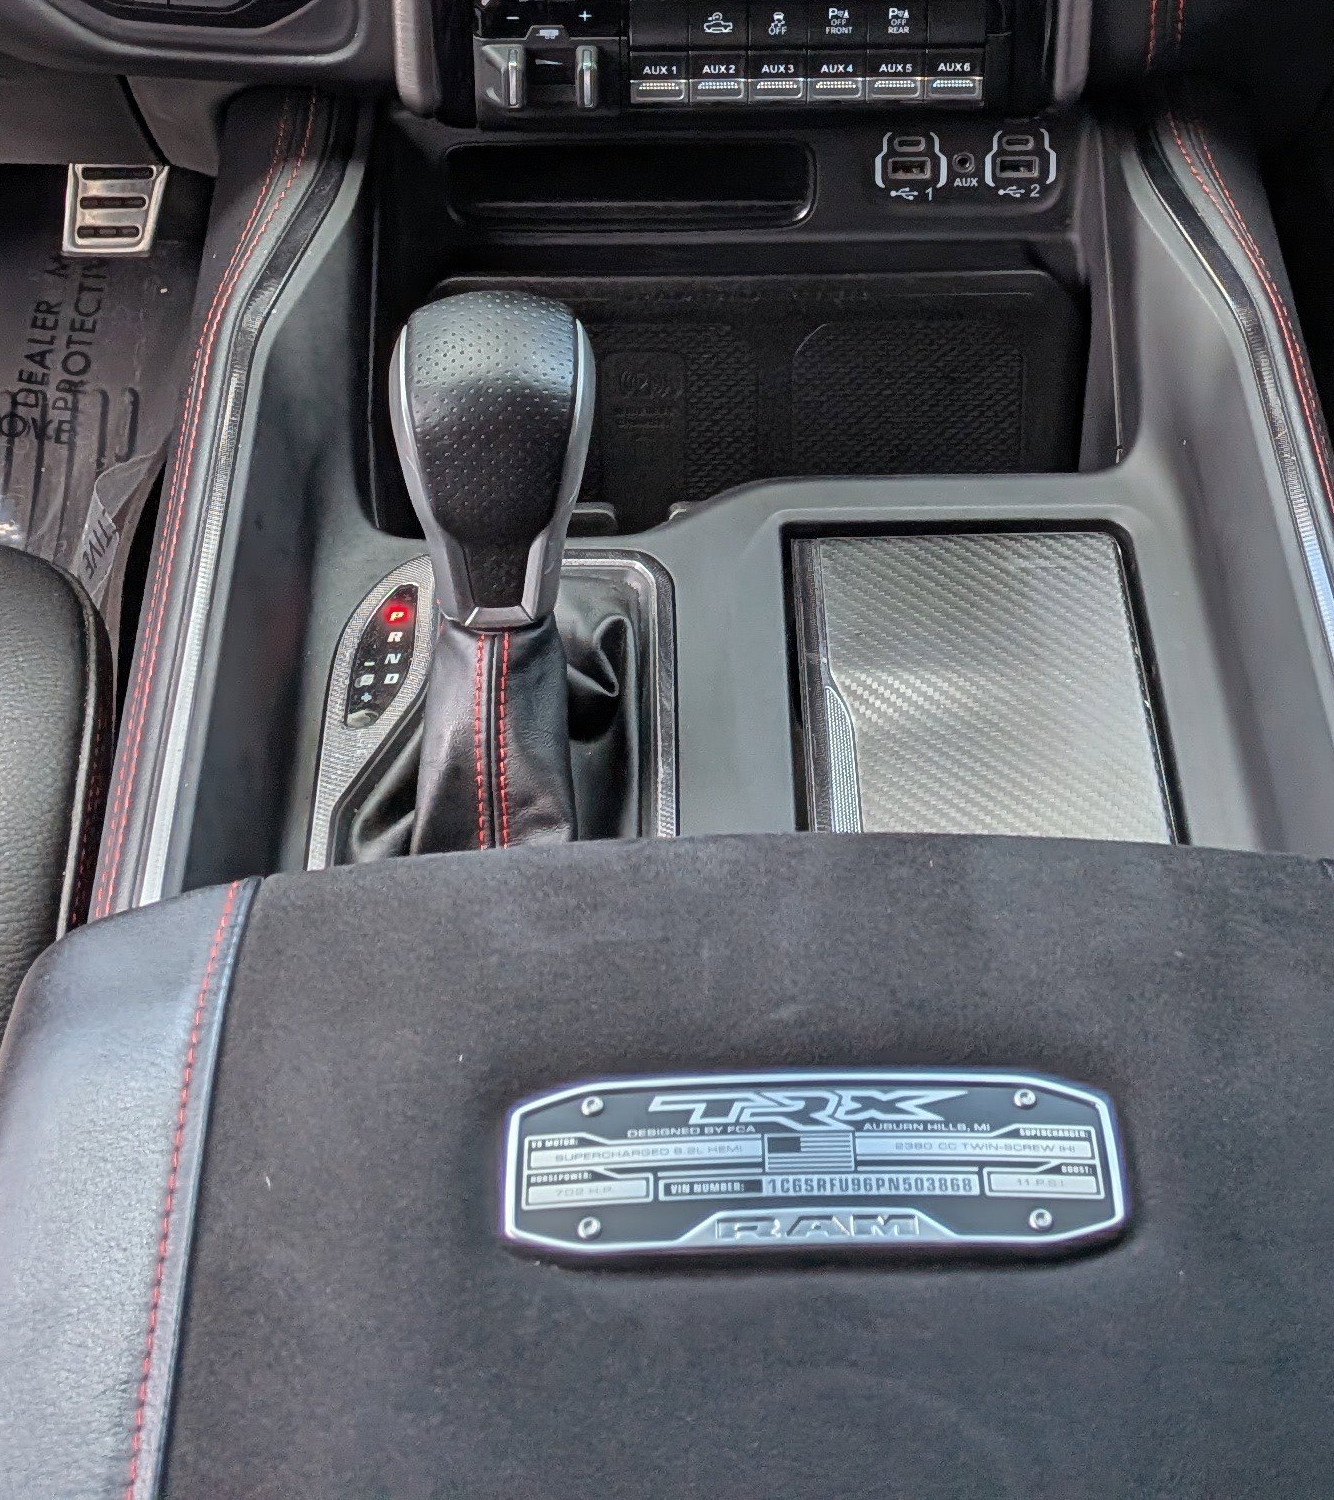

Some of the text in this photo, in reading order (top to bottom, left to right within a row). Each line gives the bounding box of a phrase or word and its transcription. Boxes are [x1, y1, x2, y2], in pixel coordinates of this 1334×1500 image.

[768, 26, 787, 35] OFF
[825, 26, 853, 35] FRONT
[888, 26, 910, 34] REAR
[643, 65, 677, 75] AUX 1
[703, 64, 735, 74] AUX 2
[761, 64, 794, 74] AUX 3
[820, 63, 854, 73] AUX 4
[879, 63, 912, 73] AUX 5
[937, 62, 971, 72] AUX 6
[954, 177, 978, 187] AUX
[925, 186, 933, 201] 1
[1030, 183, 1040, 197] 2
[17, 299, 63, 409] DEALER
[389, 611, 405, 622] P
[387, 631, 403, 642] R
[384, 653, 402, 664] N
[384, 673, 400, 684] D
[648, 1089, 968, 1130] TRX
[627, 1125, 756, 1138] DESIGNED BY FCA
[863, 1122, 923, 1132] AUBURN
[979, 1123, 991, 1131] MI
[938, 1142, 1055, 1152] CC TWIN-SCREW
[555, 1145, 743, 1162] SUPERCHARGED HEMI
[670, 1183, 690, 1194] VIN
[716, 1214, 919, 1239] RAM
